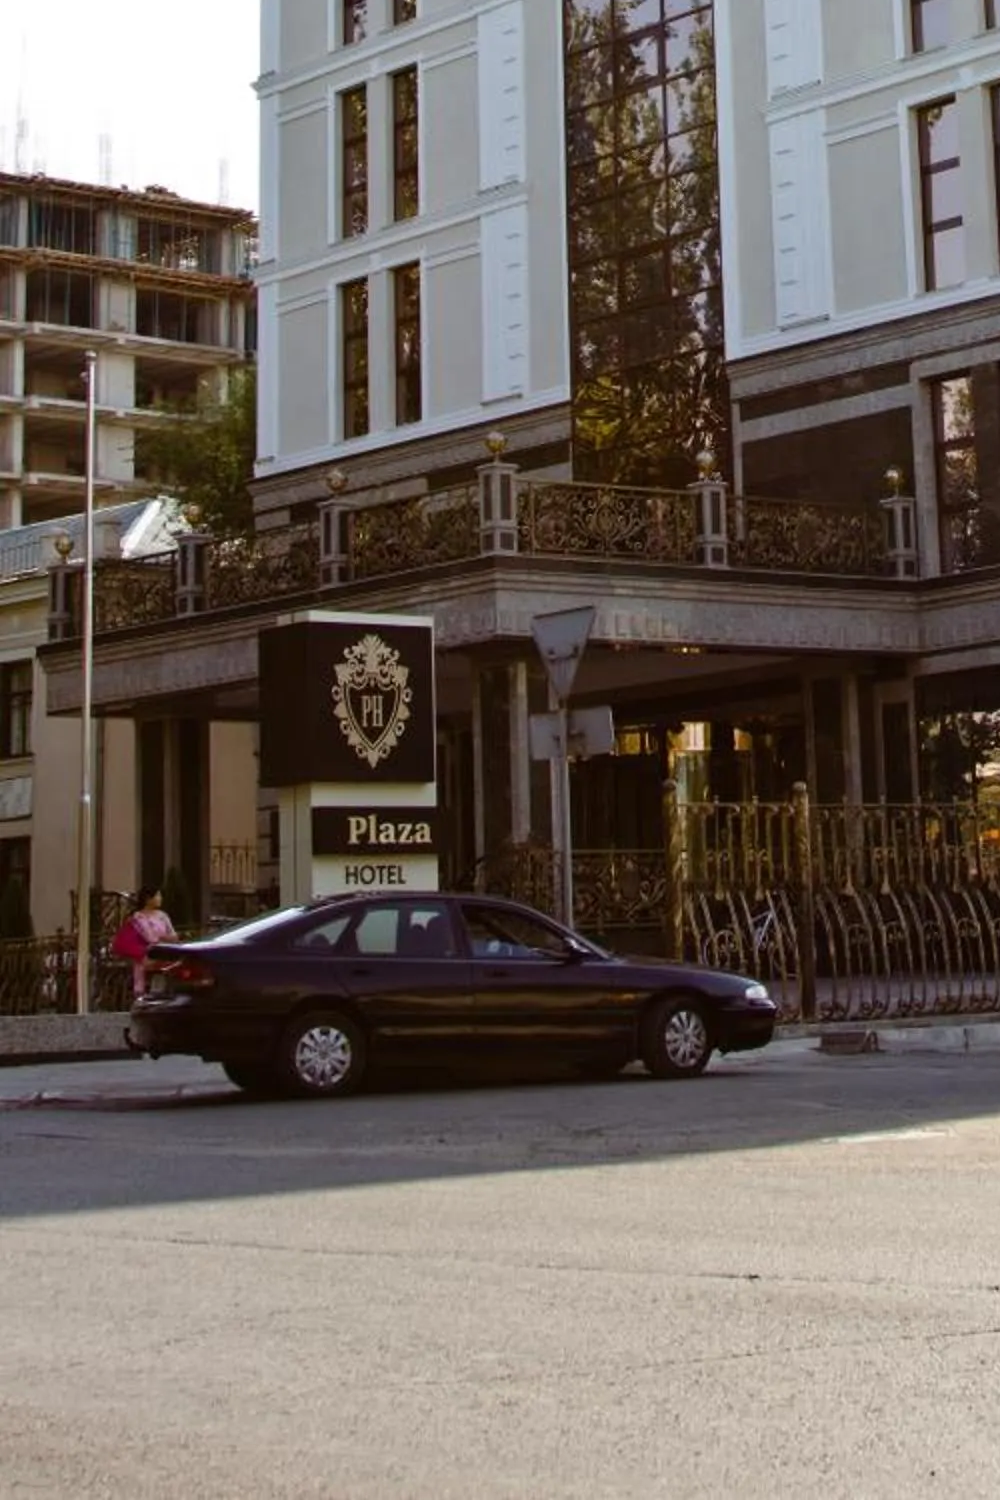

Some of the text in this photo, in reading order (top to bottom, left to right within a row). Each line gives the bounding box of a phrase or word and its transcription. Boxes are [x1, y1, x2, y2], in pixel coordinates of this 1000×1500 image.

[360, 695, 384, 728] PH
[347, 813, 433, 845] Plaza
[345, 864, 406, 885] HOTEL
